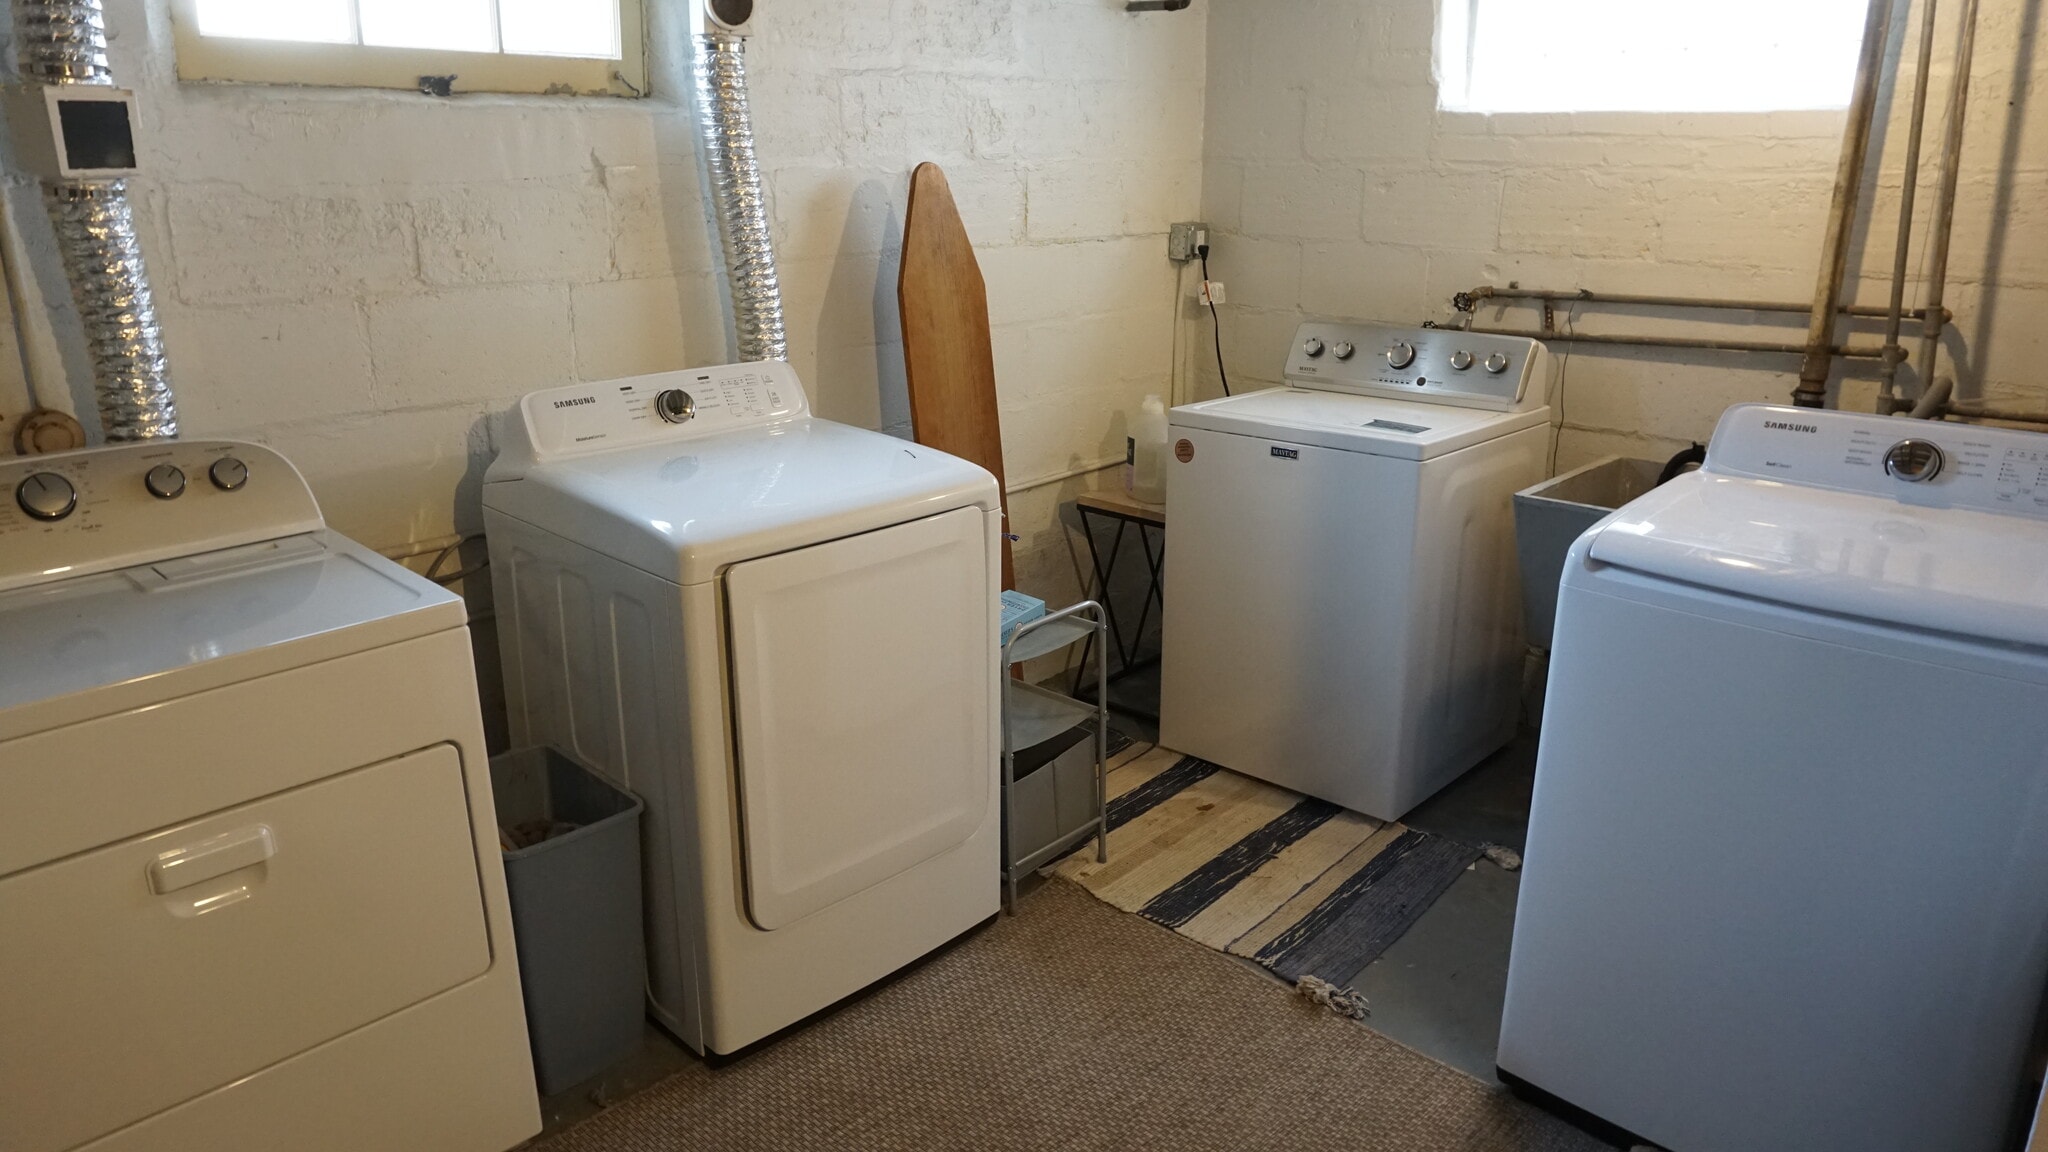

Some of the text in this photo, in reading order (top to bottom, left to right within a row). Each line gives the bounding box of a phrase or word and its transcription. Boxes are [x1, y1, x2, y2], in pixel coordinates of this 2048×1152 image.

[554, 396, 596, 409] SAMSUNG
[1764, 420, 1818, 434] SAMSUNG
[1272, 448, 1298, 458] MAYTAG
